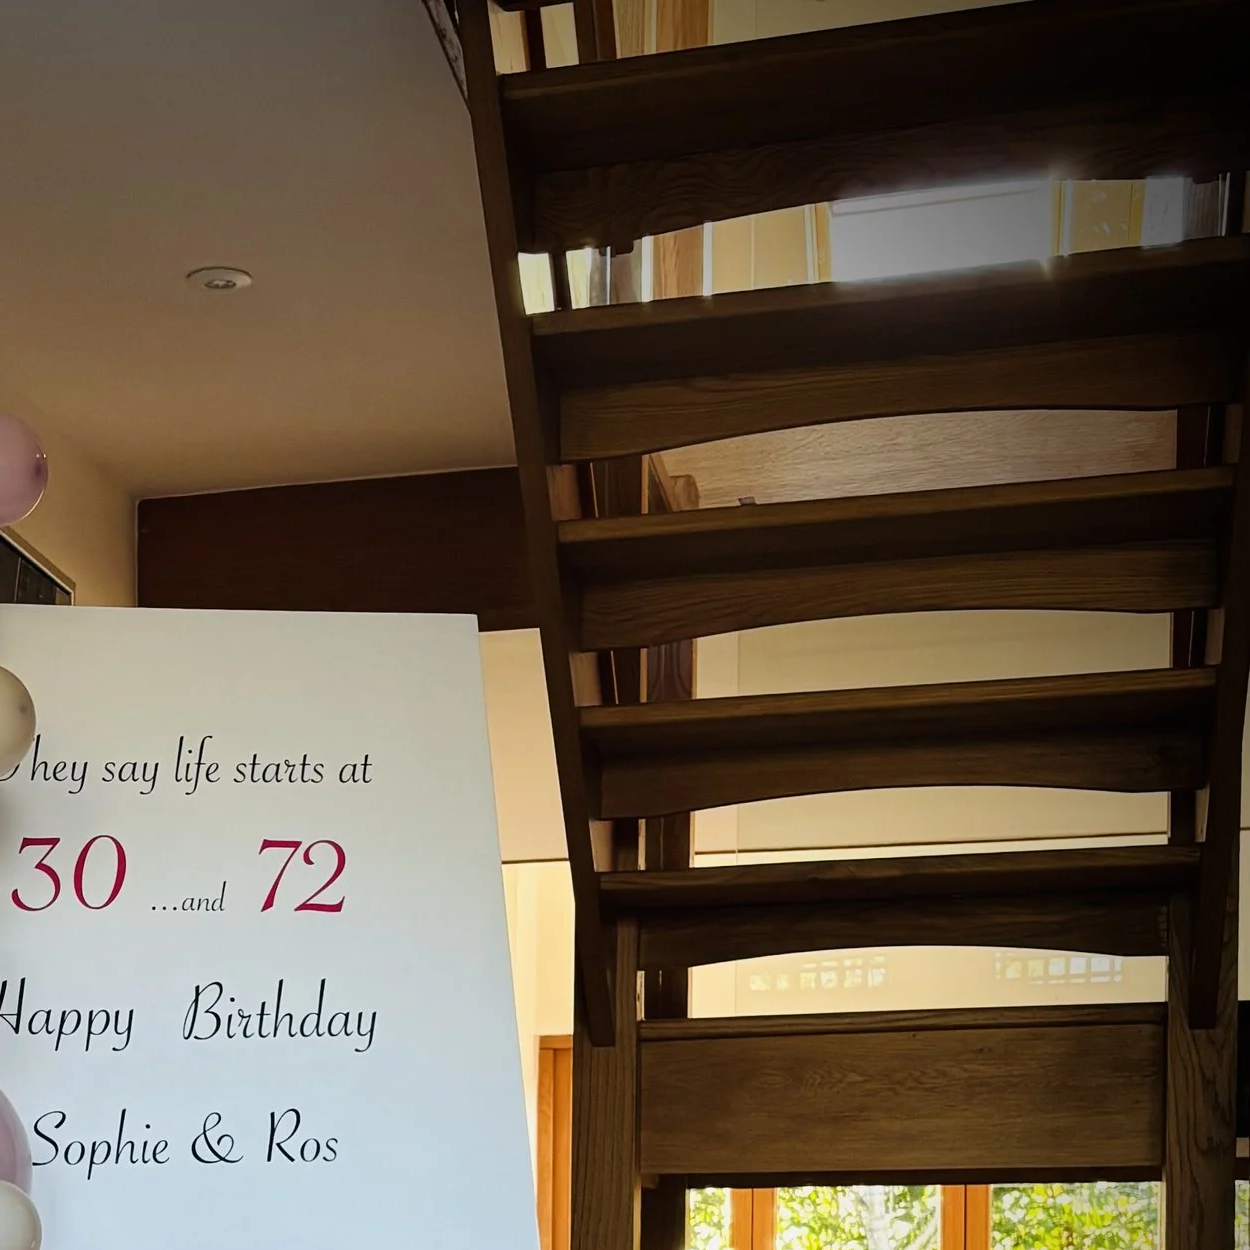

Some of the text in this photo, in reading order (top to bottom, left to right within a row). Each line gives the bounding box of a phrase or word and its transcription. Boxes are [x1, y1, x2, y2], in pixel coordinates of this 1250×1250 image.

[0, 734, 373, 796] hey say life starts at
[11, 834, 347, 914] 30 ...and 72
[182, 977, 378, 1053] Birthday
[31, 1107, 339, 1181] Sophie & Ros
